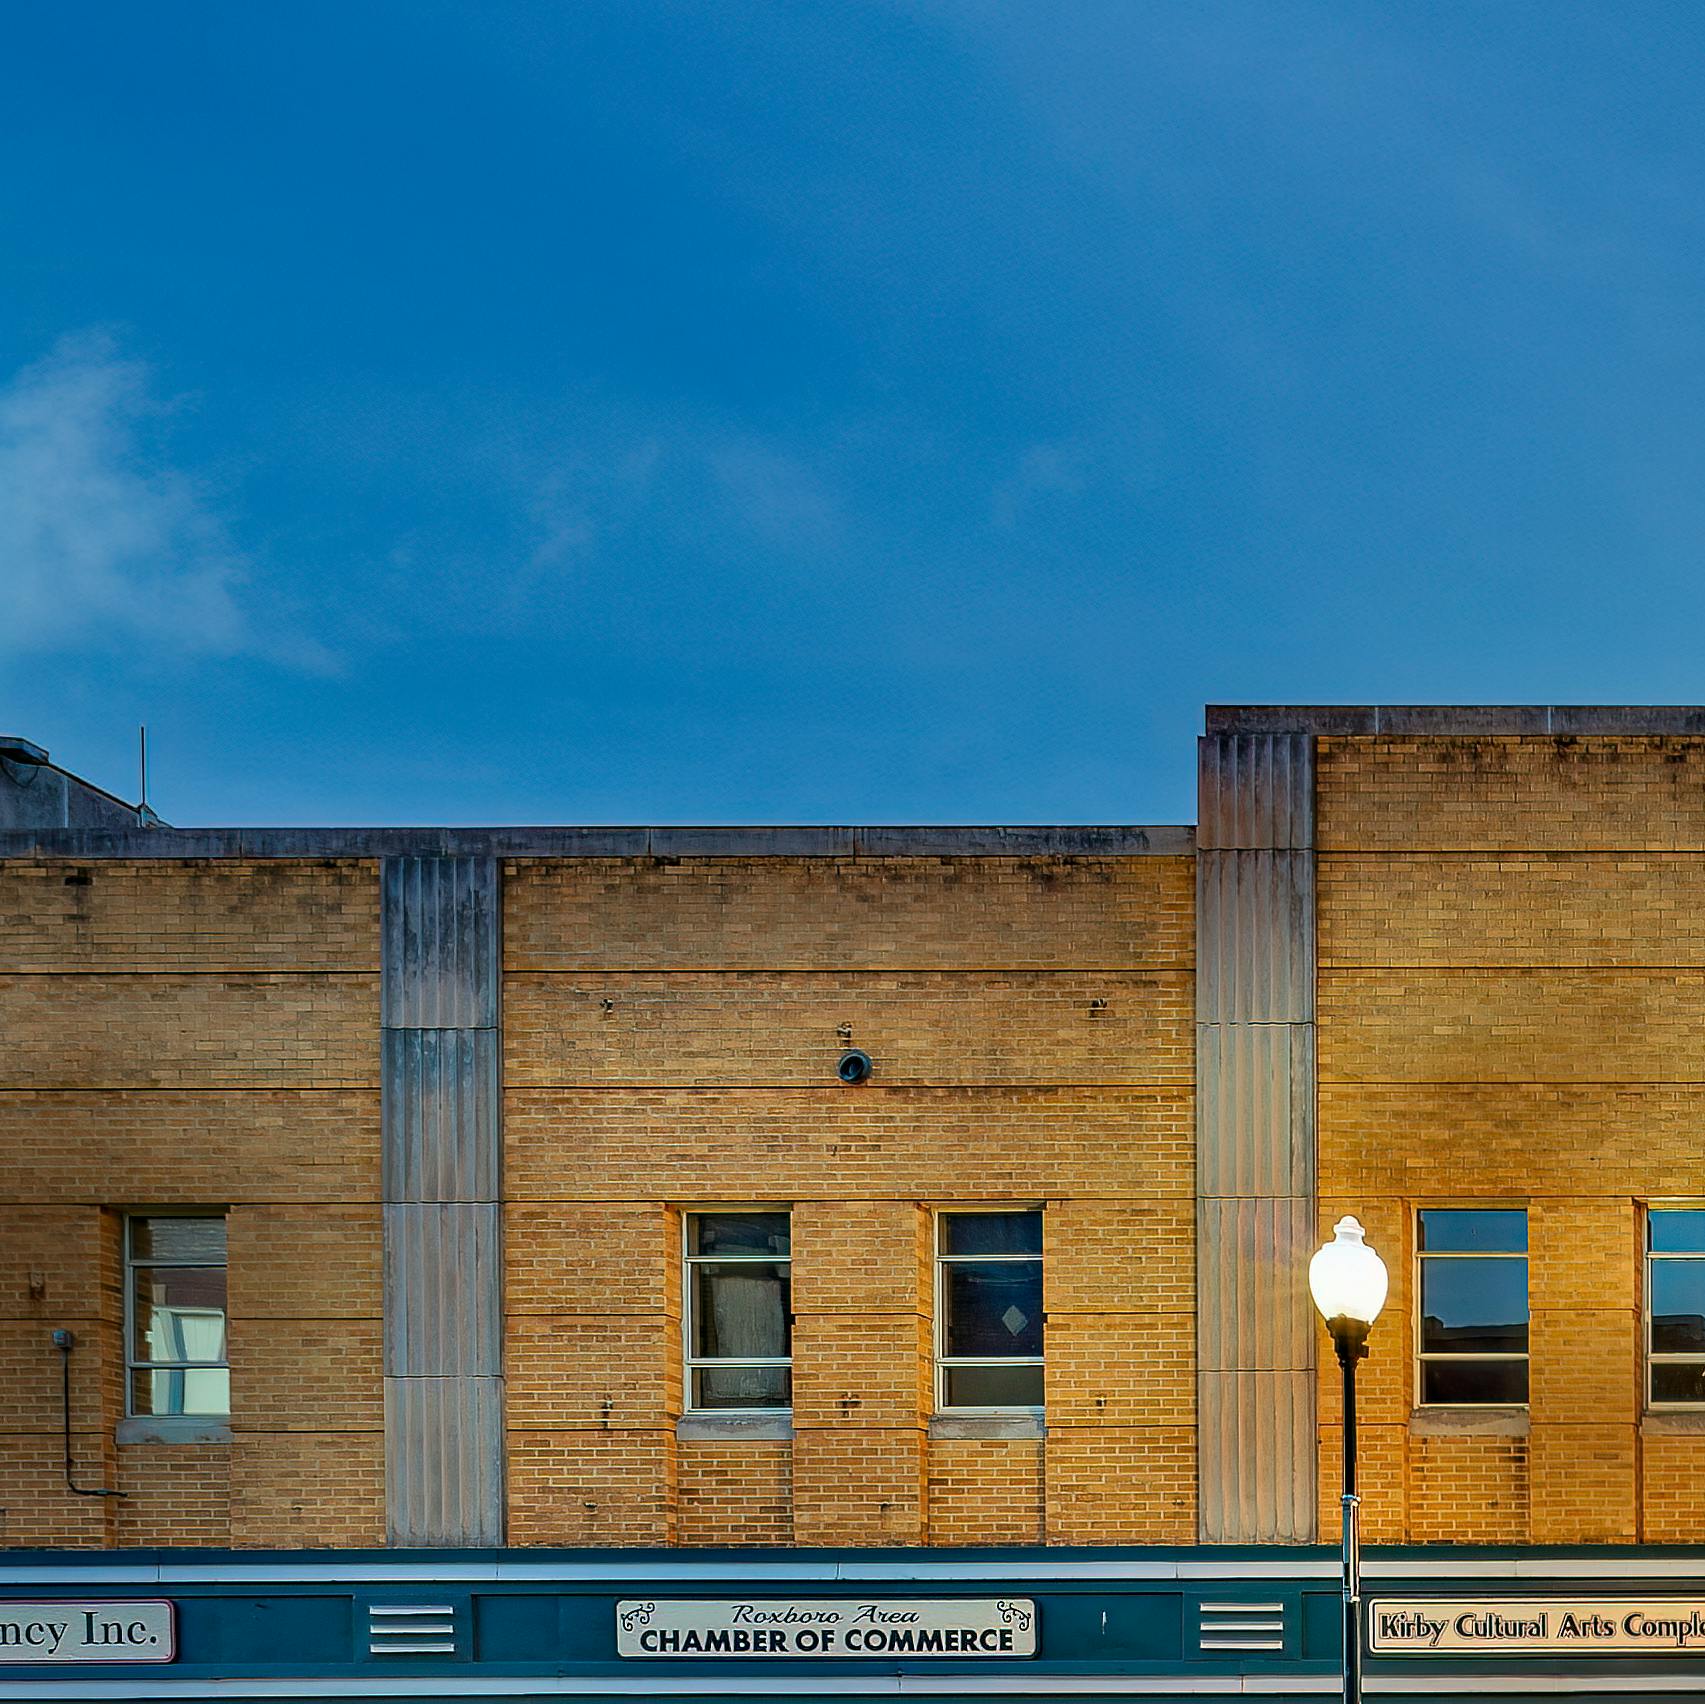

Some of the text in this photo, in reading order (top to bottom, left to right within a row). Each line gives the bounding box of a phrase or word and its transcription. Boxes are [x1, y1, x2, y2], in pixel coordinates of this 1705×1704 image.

[80, 1611, 157, 1645] Inc.
[731, 1603, 920, 1625] Roxboro Area
[640, 1628, 1013, 1653] CHAMBER OF COMMERCE
[1378, 1611, 1449, 1647] Kirby
[1454, 1612, 1548, 1639] Cultural
[1557, 1612, 1617, 1639] Arts
